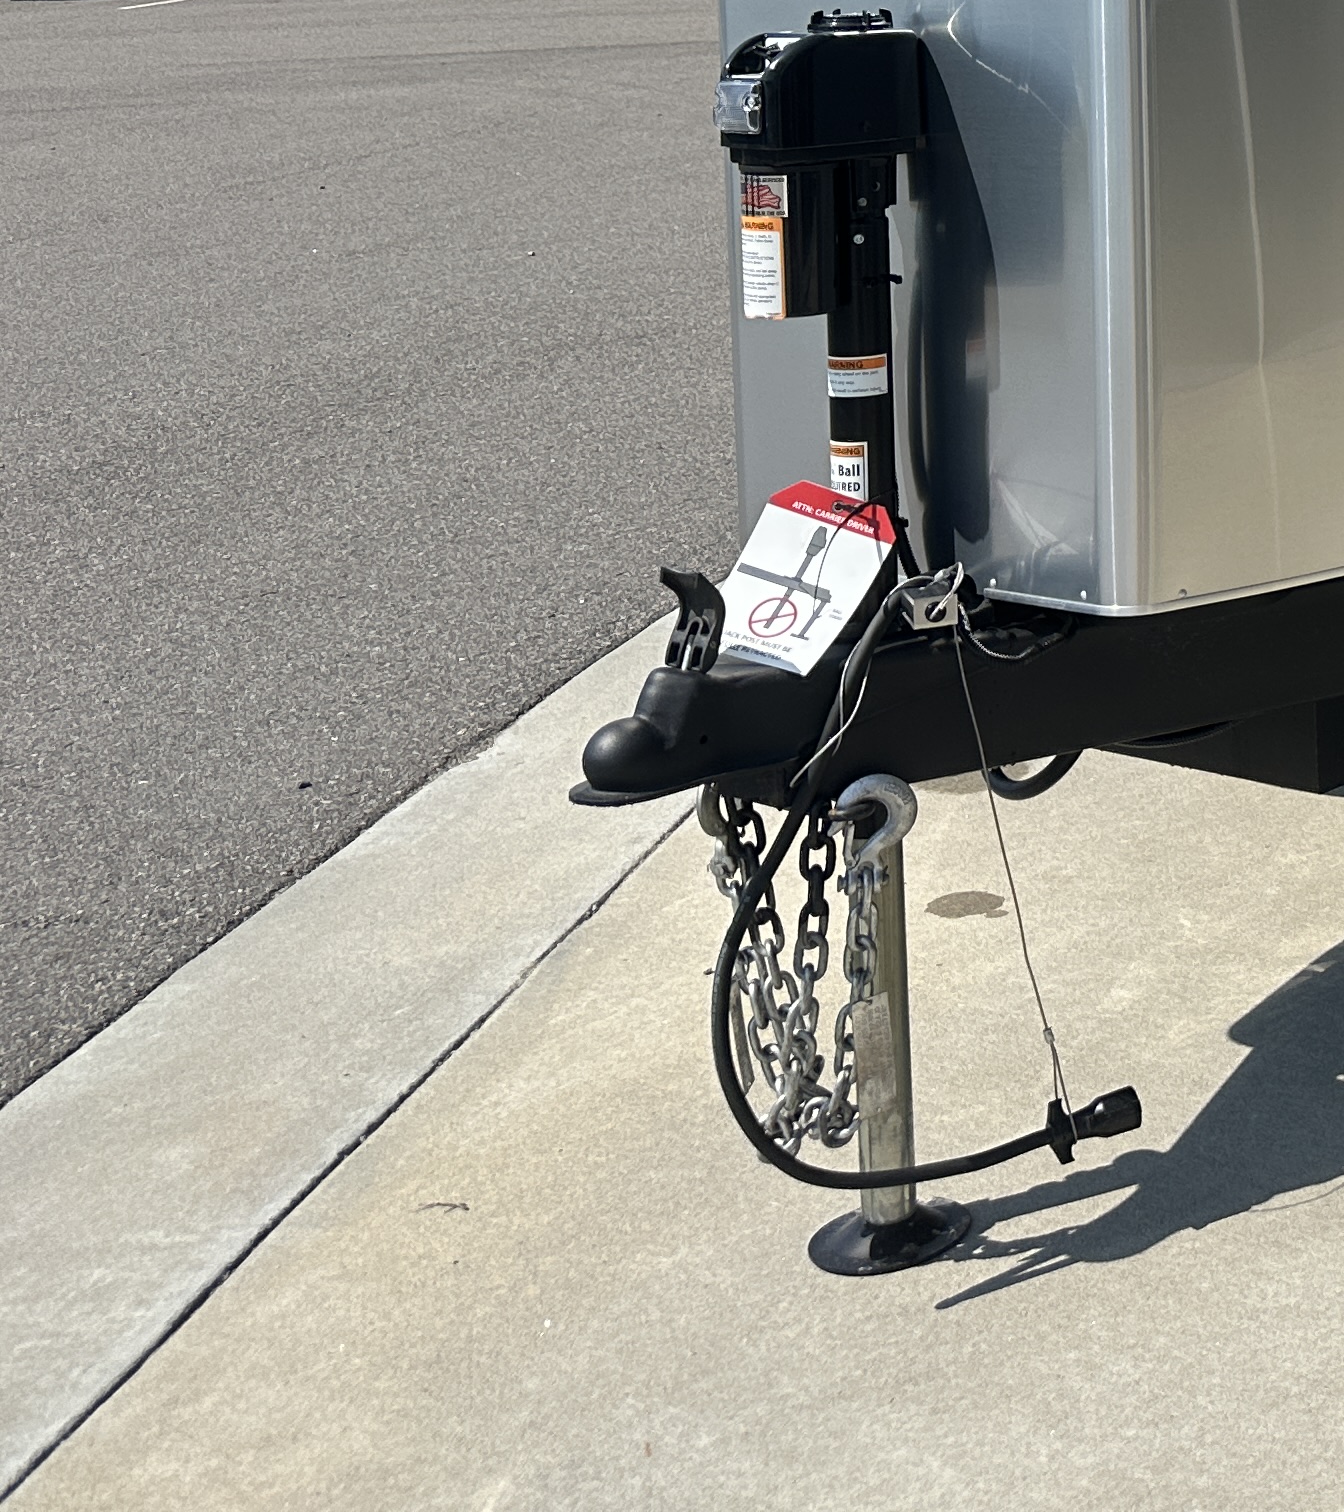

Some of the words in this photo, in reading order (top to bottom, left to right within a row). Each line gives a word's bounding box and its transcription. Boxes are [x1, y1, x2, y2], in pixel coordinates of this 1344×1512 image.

[838, 463, 860, 477] Ball
[792, 501, 814, 515] ATTN:
[846, 519, 875, 535] DRIVER
